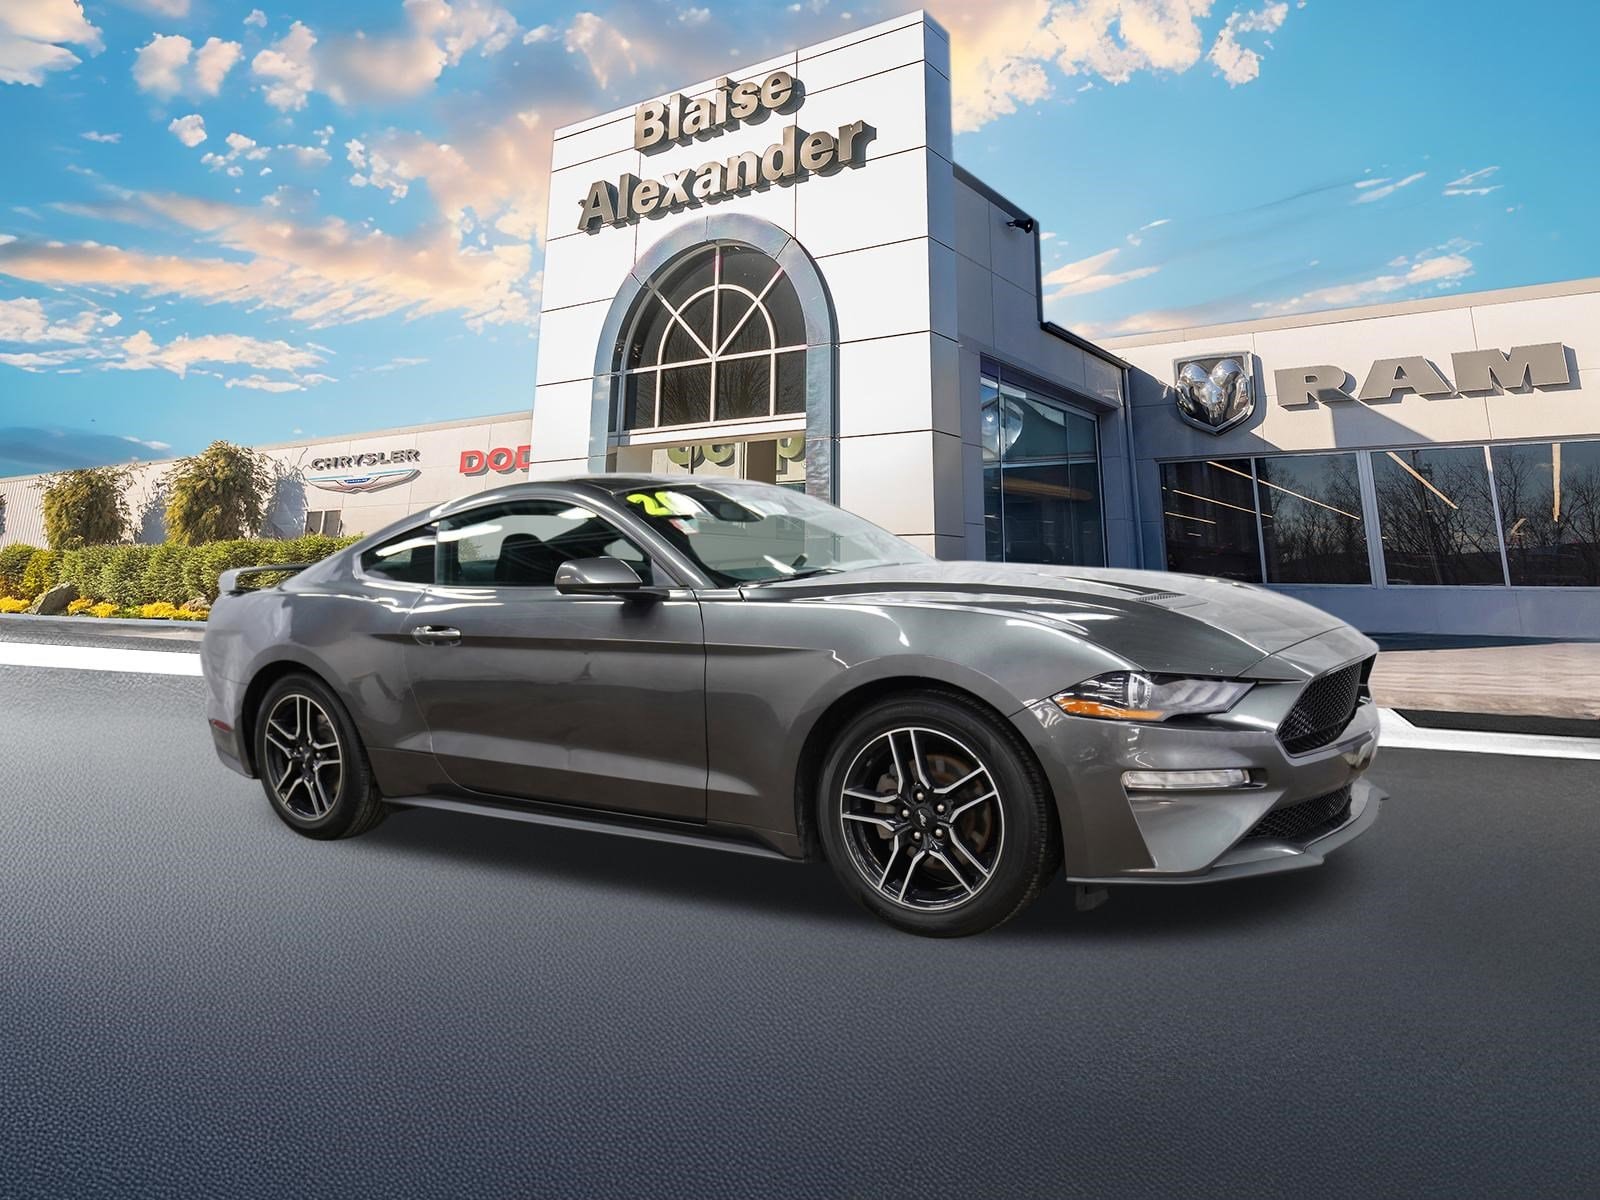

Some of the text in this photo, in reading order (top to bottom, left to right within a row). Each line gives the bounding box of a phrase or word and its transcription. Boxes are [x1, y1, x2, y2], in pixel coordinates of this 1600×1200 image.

[634, 71, 799, 156] Blaise
[577, 120, 870, 233] Alexander
[1273, 342, 1574, 410] RAM
[311, 448, 420, 472] CHRYSLER
